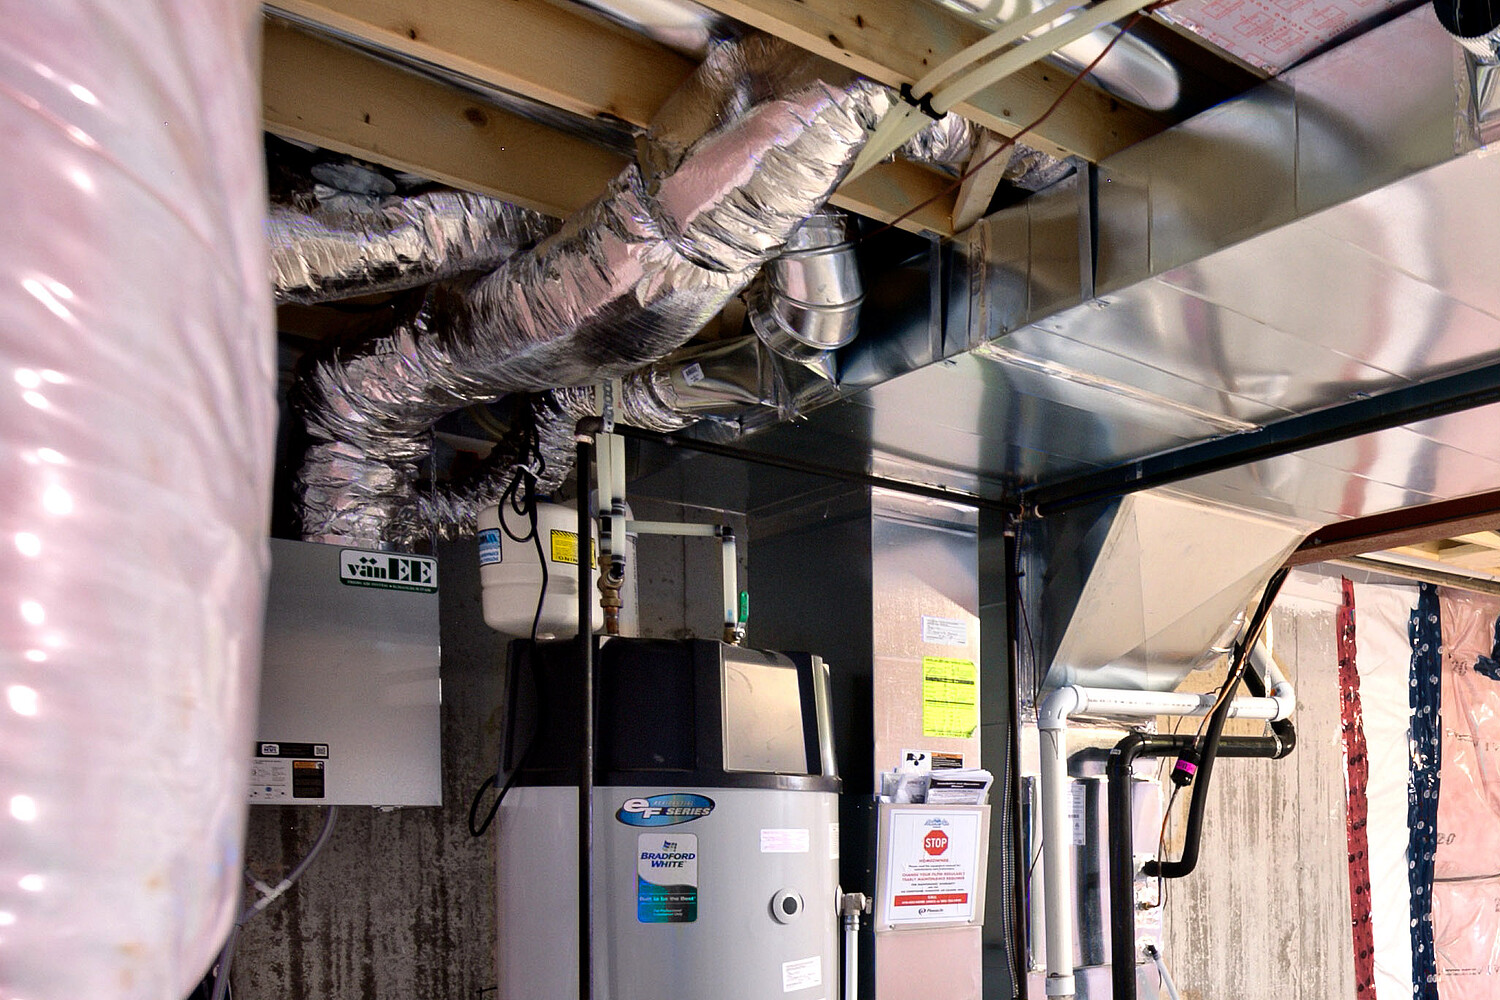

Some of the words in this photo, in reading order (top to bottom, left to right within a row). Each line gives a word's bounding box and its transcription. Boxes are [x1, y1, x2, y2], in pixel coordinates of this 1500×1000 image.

[347, 556, 432, 584] vänEE
[666, 807, 711, 816] SERIES
[925, 838, 947, 848] STOP
[1436, 833, 1457, 845] 20
[640, 852, 696, 860] BRADFORD
